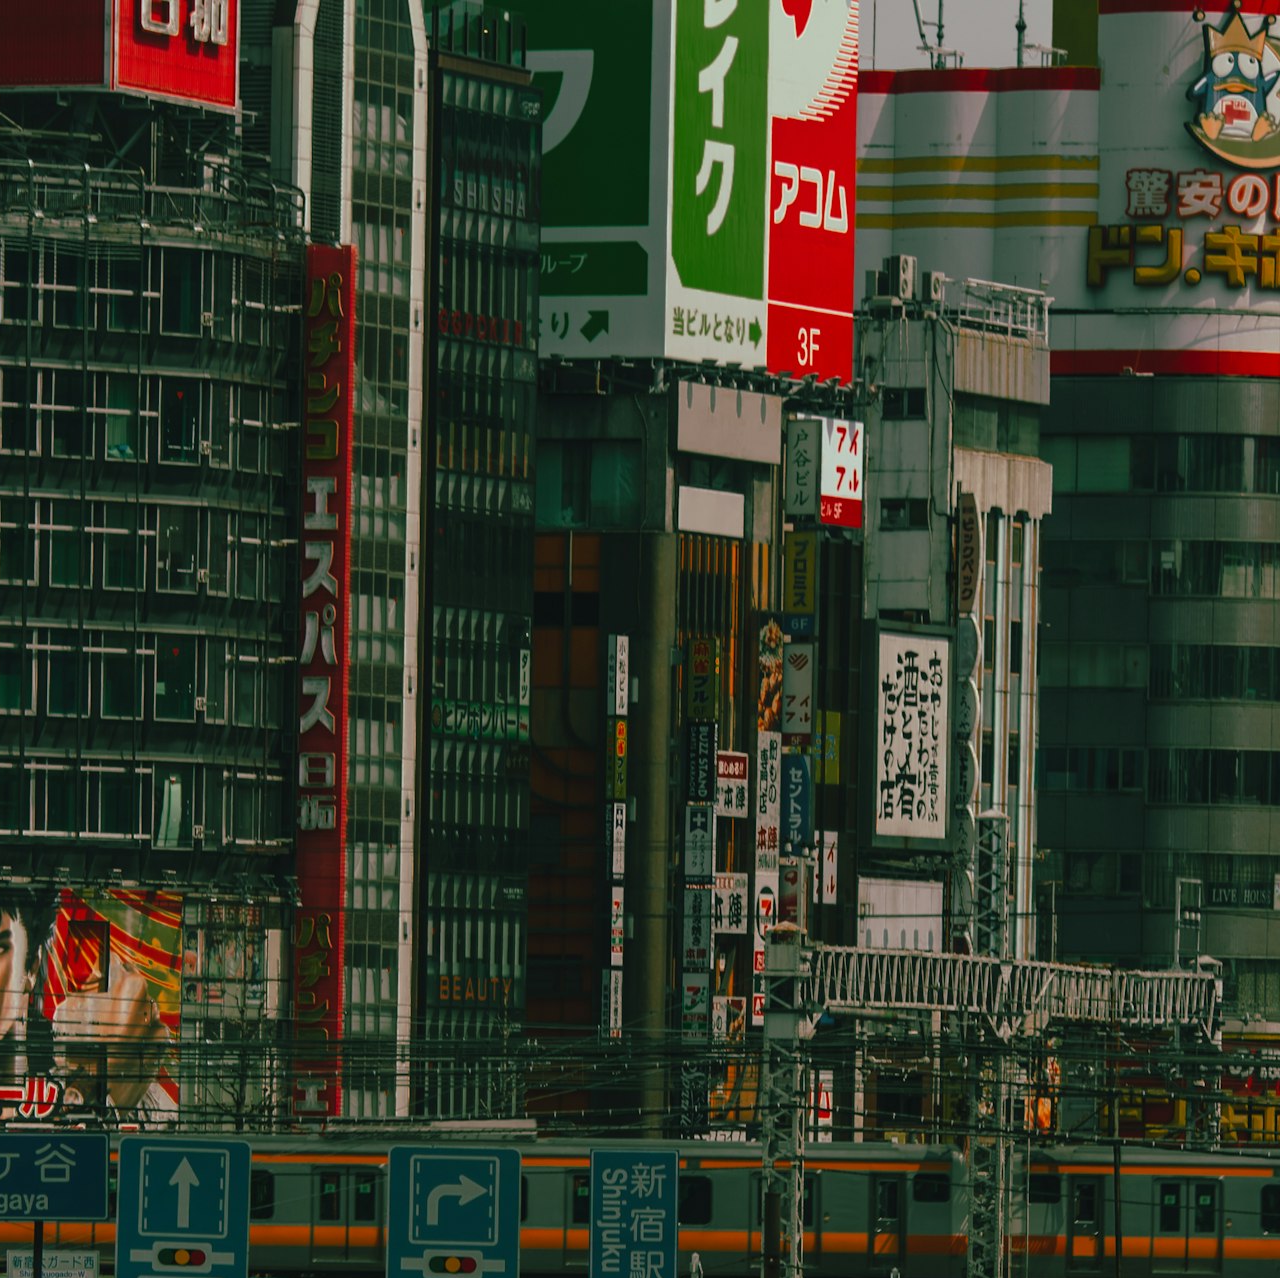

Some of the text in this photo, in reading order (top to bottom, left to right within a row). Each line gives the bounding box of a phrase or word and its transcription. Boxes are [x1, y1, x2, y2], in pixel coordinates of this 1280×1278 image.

[773, 160, 849, 234] アコム
[672, 306, 747, 346] 当ビルとなり
[796, 326, 821, 367] 3F
[304, 273, 347, 461] パチンコ
[792, 427, 811, 507] 戸谷ビル
[792, 539, 810, 608] プロミス
[296, 474, 340, 832] エスパス日拓
[790, 617, 809, 631] 6F
[880, 673, 897, 820] だけの店
[896, 650, 919, 822] 酒と肴
[788, 766, 803, 848] セントラル
[438, 975, 513, 1003] BEAUTY
[600, 1166, 629, 1275] Shinjuku
